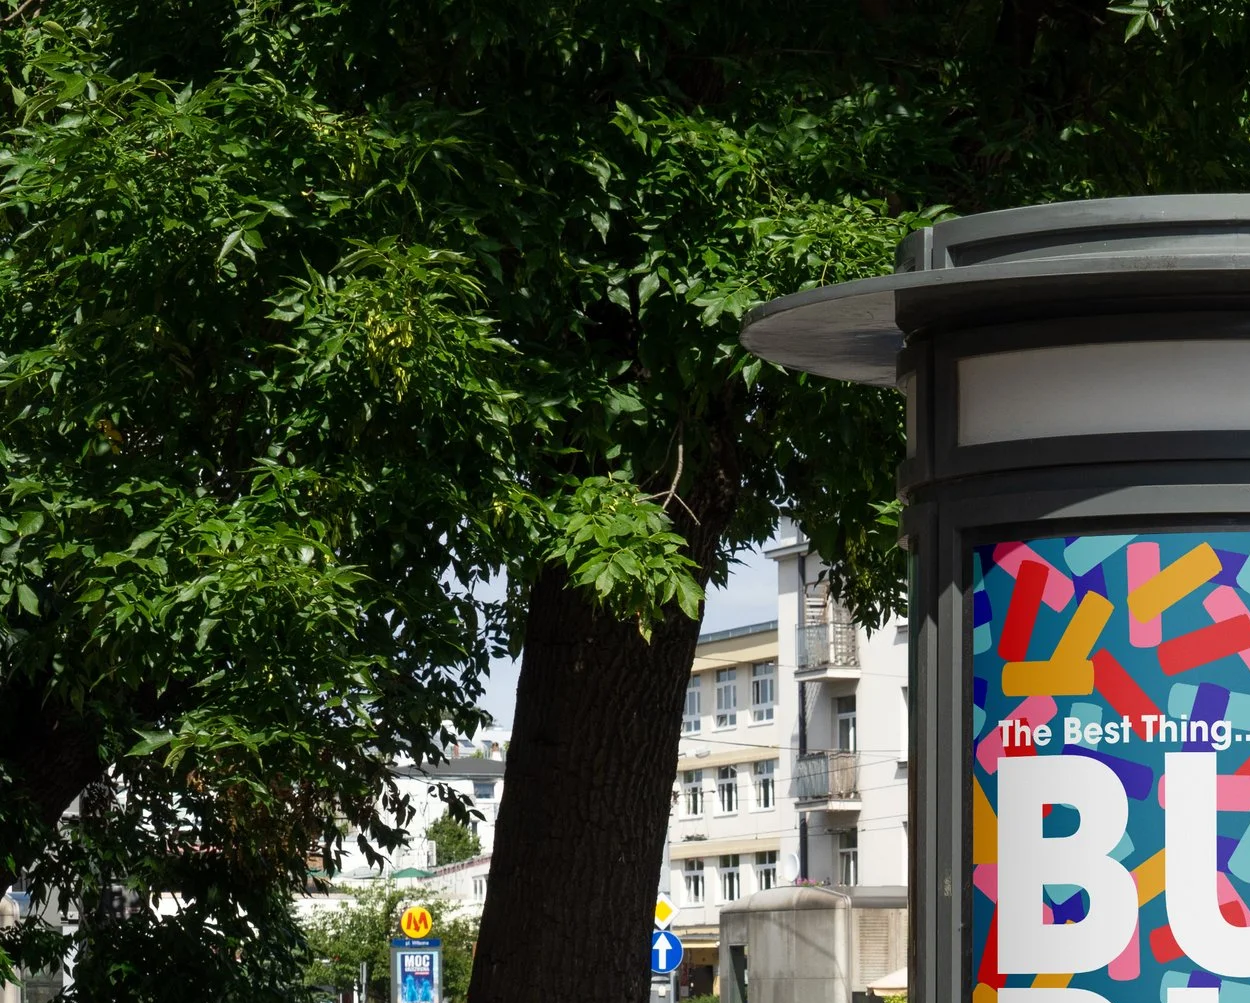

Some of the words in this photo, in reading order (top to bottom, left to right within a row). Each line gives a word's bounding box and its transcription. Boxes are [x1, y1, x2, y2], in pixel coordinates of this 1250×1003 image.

[998, 719, 1052, 748] The
[1064, 715, 1132, 745] Best
[404, 955, 430, 967] MOC
